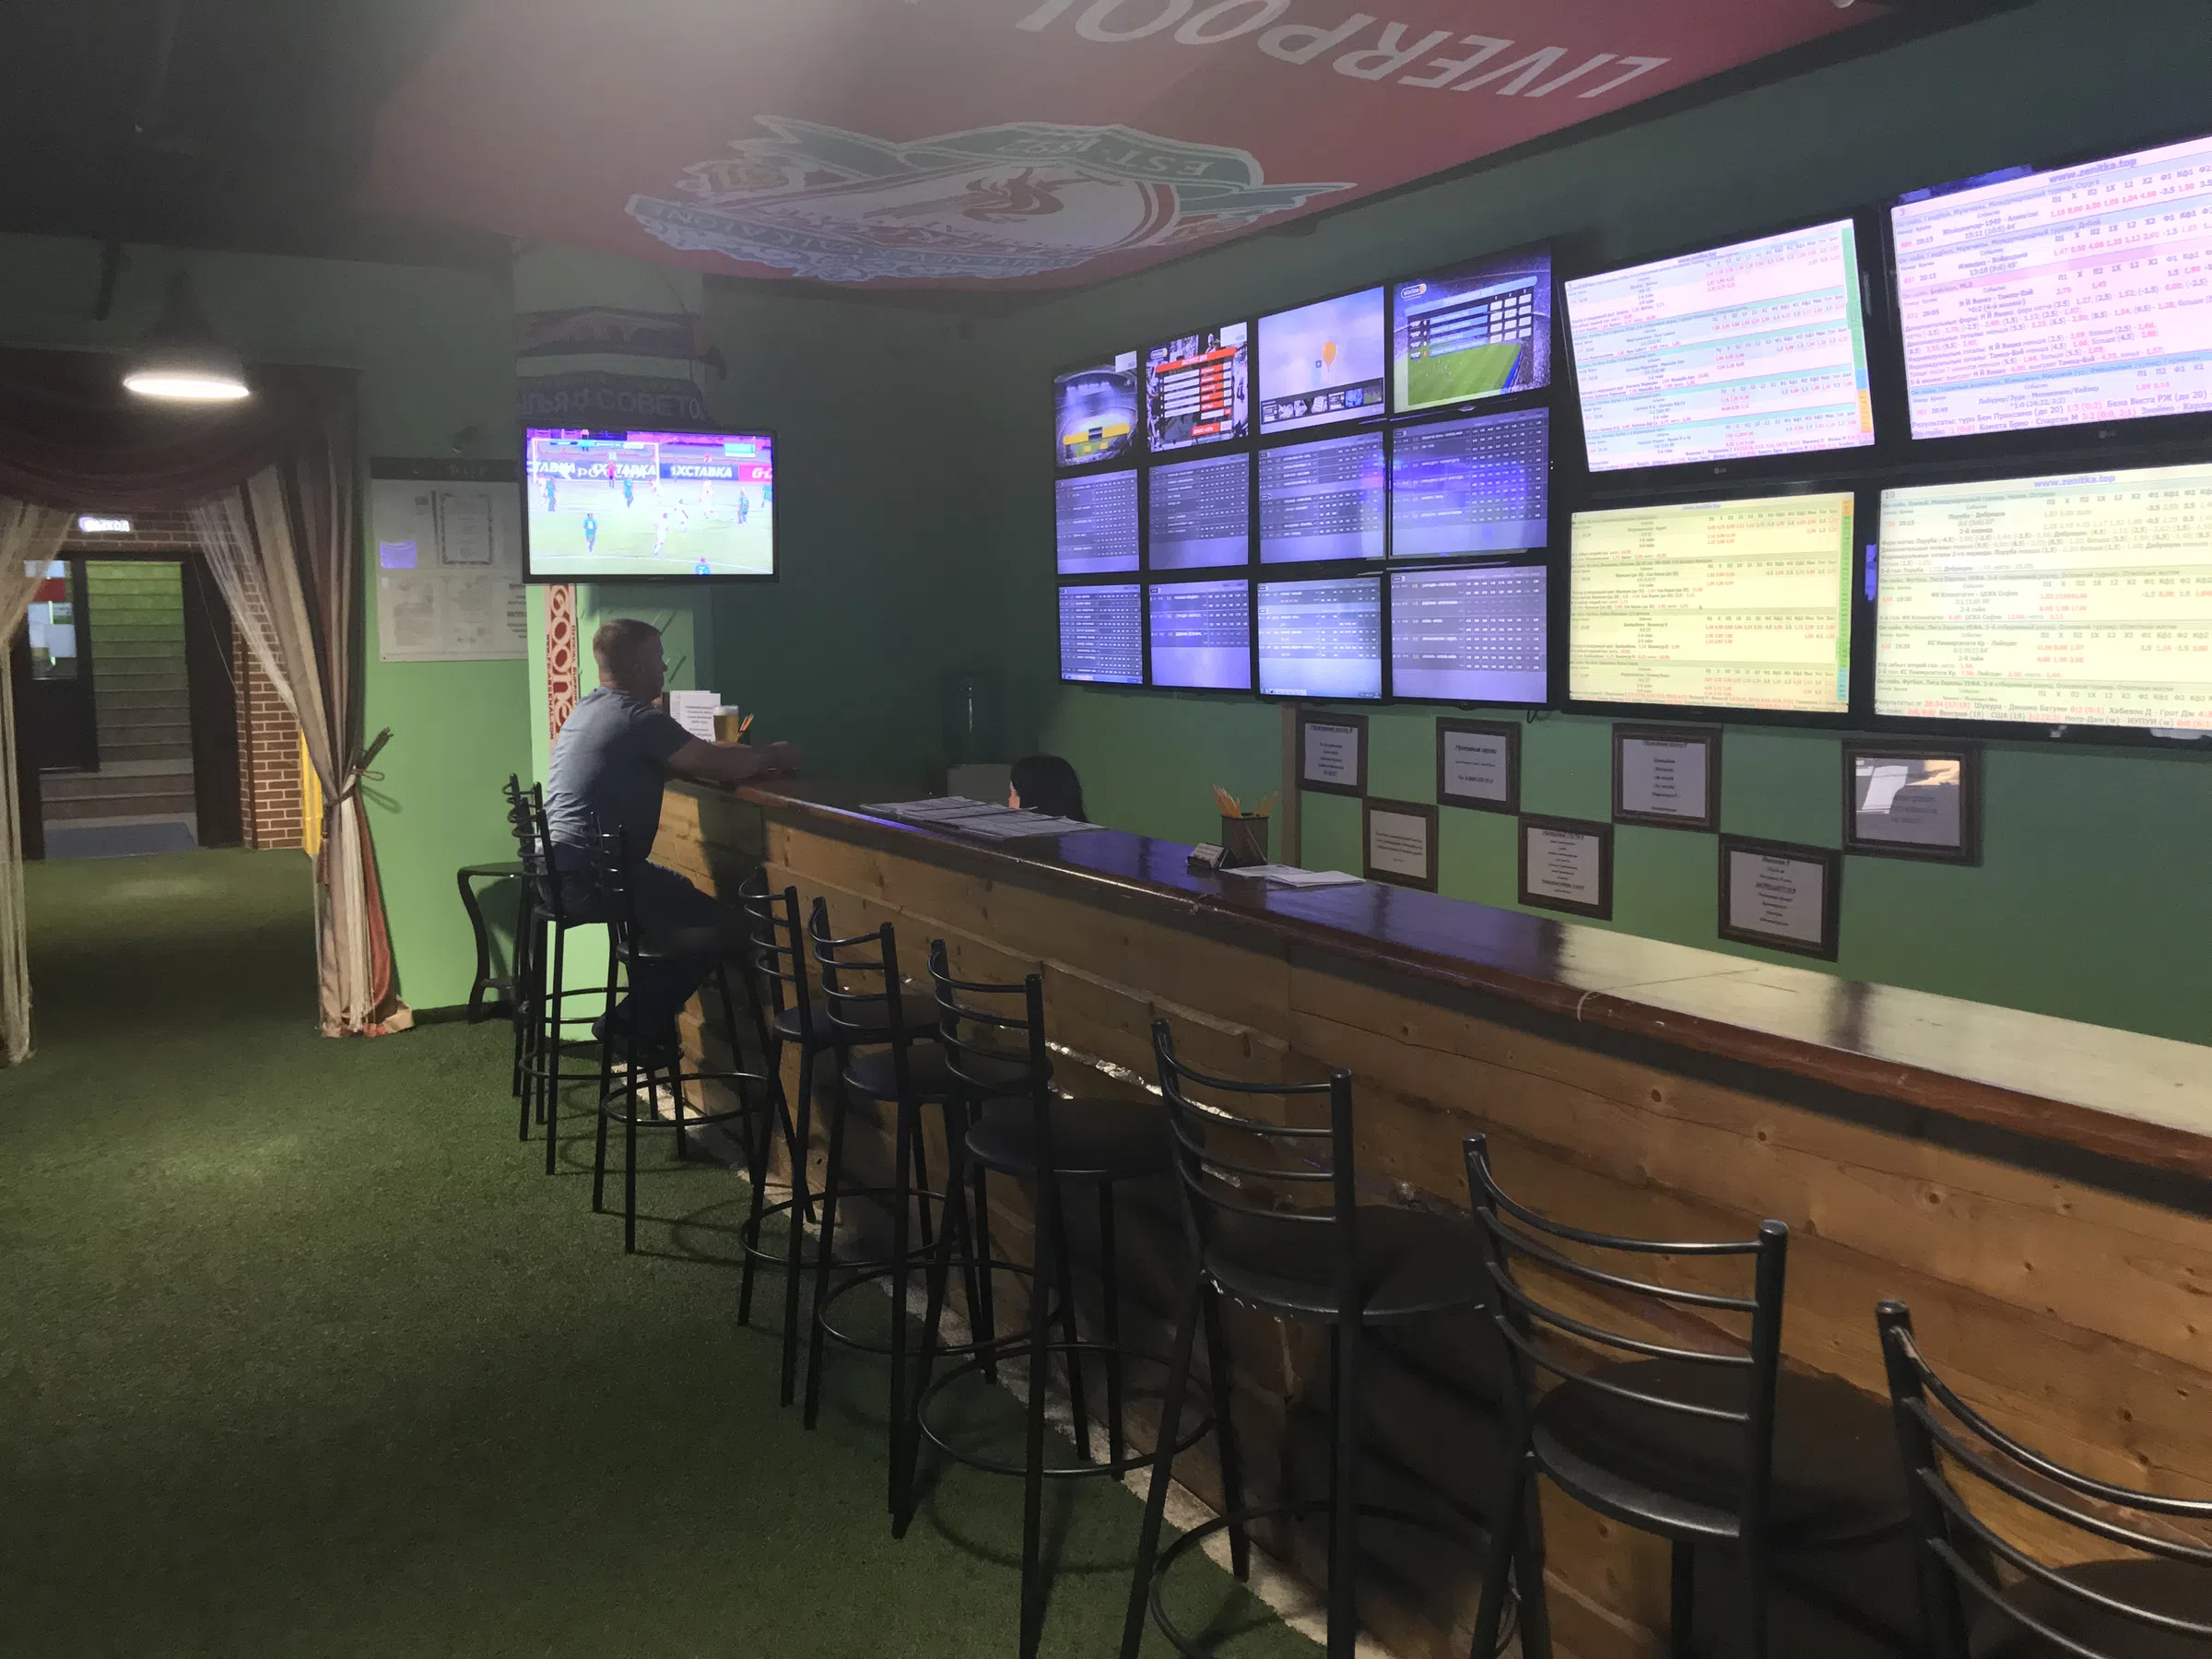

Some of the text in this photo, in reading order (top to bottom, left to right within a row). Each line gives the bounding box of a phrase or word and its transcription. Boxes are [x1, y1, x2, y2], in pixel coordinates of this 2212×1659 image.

[2049, 159, 2136, 183] www.zenitka.top
[2034, 475, 2115, 488] www.zenitka.top
[2160, 710, 2178, 718] Грот
